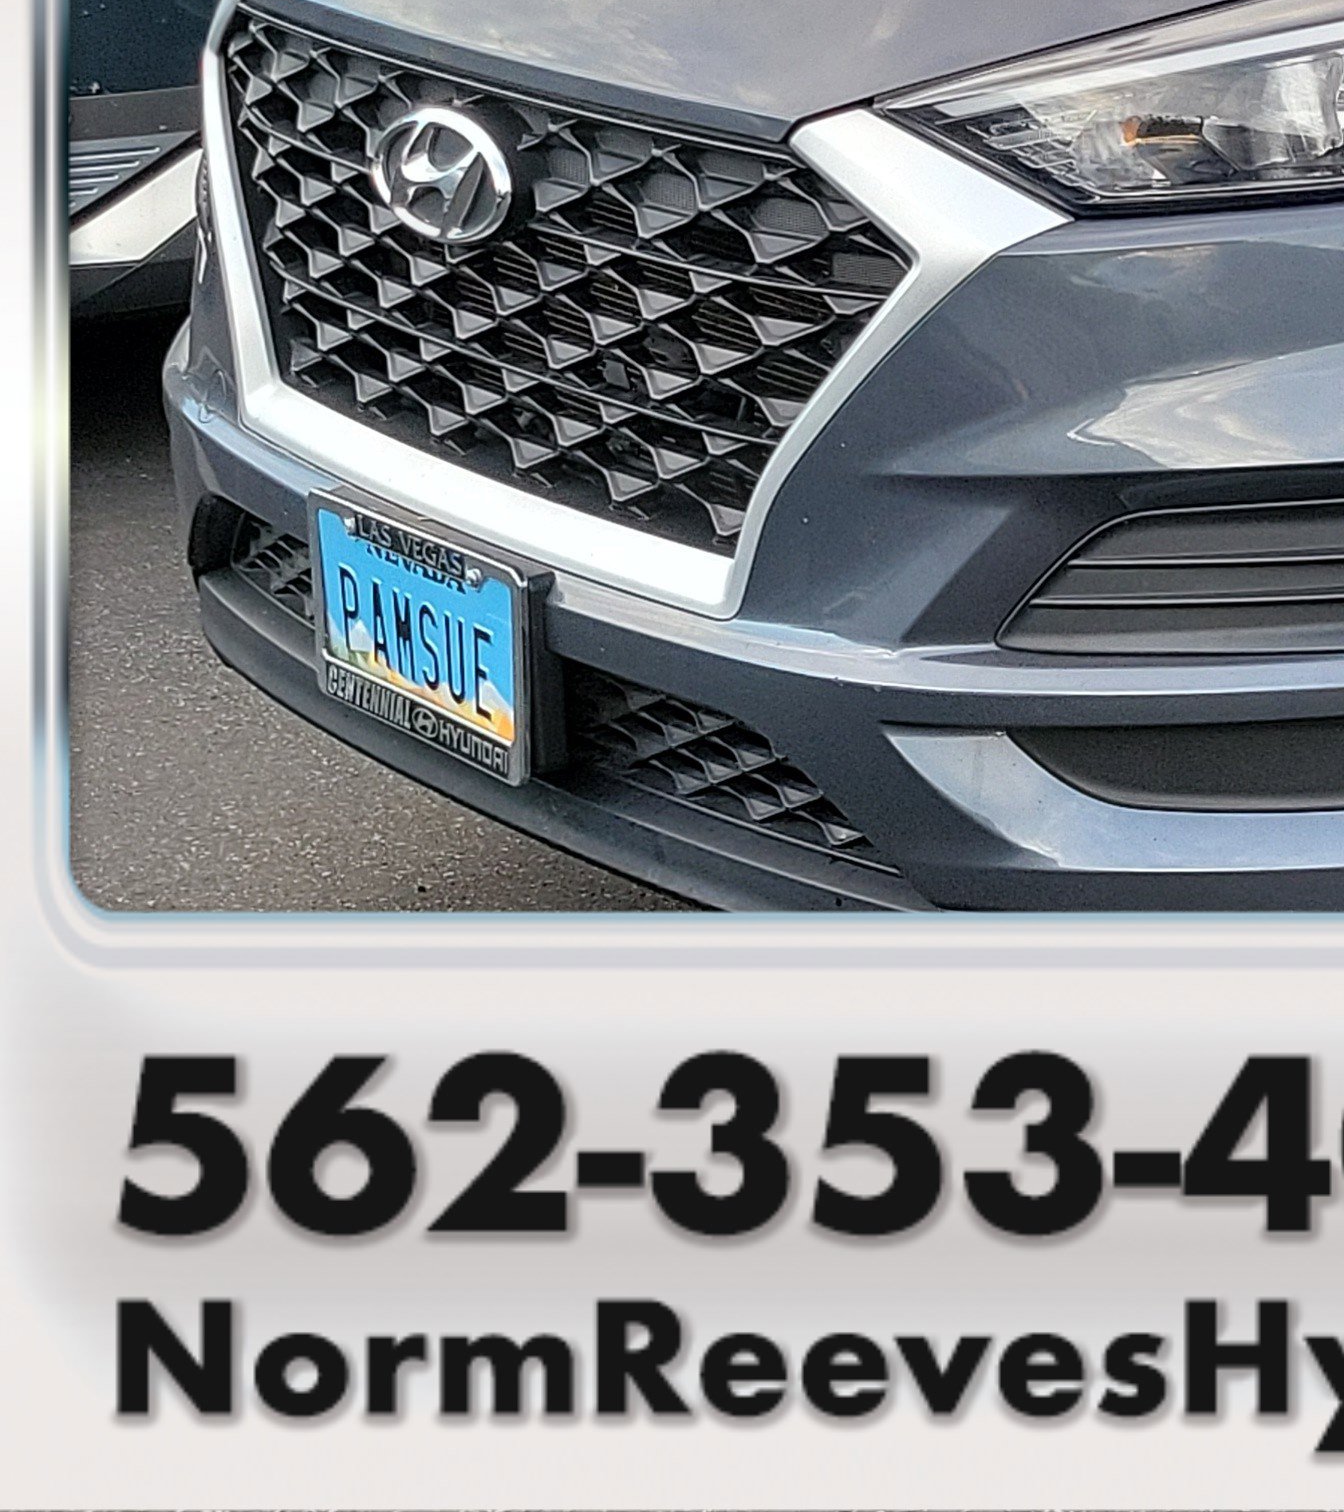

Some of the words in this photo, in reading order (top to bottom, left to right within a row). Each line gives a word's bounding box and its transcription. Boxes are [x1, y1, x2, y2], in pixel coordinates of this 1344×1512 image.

[356, 514, 392, 548] LAS
[397, 530, 463, 577] VEGAS
[327, 664, 412, 731] CENTENNIAL
[438, 718, 509, 776] HYUNDAI
